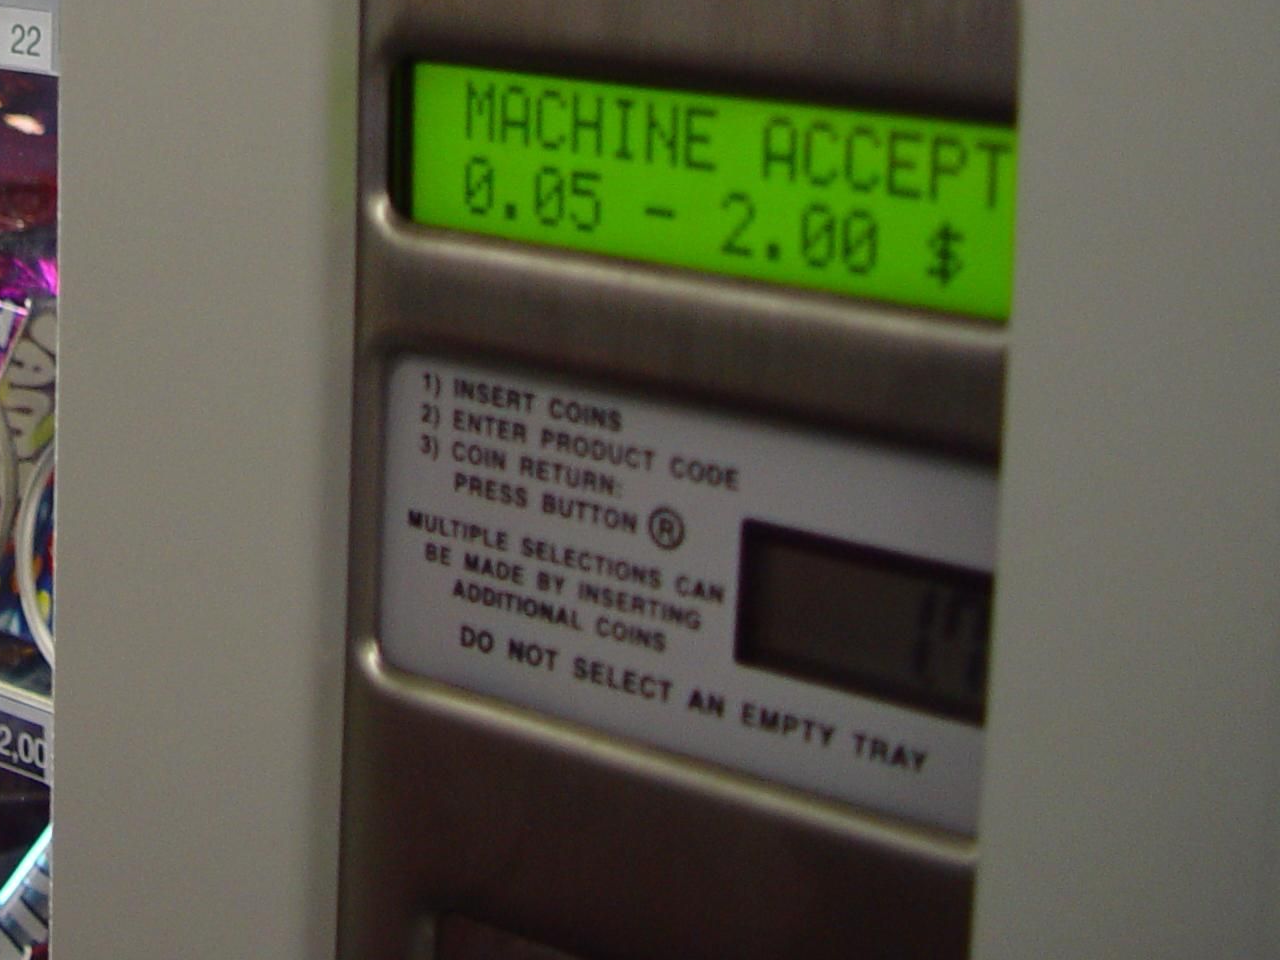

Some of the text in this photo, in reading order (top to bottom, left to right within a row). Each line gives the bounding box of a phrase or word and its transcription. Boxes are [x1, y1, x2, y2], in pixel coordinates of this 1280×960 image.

[10, 23, 42, 57] 22
[465, 80, 1012, 210] MACHINE ACCEPT
[465, 156, 601, 233] 0.05
[721, 193, 878, 276] 2.00
[928, 223, 964, 289] $
[423, 373, 623, 432] 1) INSERT COINS
[421, 404, 740, 491] 2) ENTER PRODUCT CODE
[421, 434, 440, 462] 3)
[452, 441, 507, 471] COIN
[454, 471, 529, 509] PRESS
[541, 493, 638, 534] BUTTON
[407, 509, 726, 605] MULTIPLE SELECTIONS CAN
[424, 542, 703, 632] BE MADE BY INSERTING
[452, 578, 668, 654] ADDITIONAL COINS
[460, 625, 929, 774] DO NOT SELECT AN EMPTY TRAY
